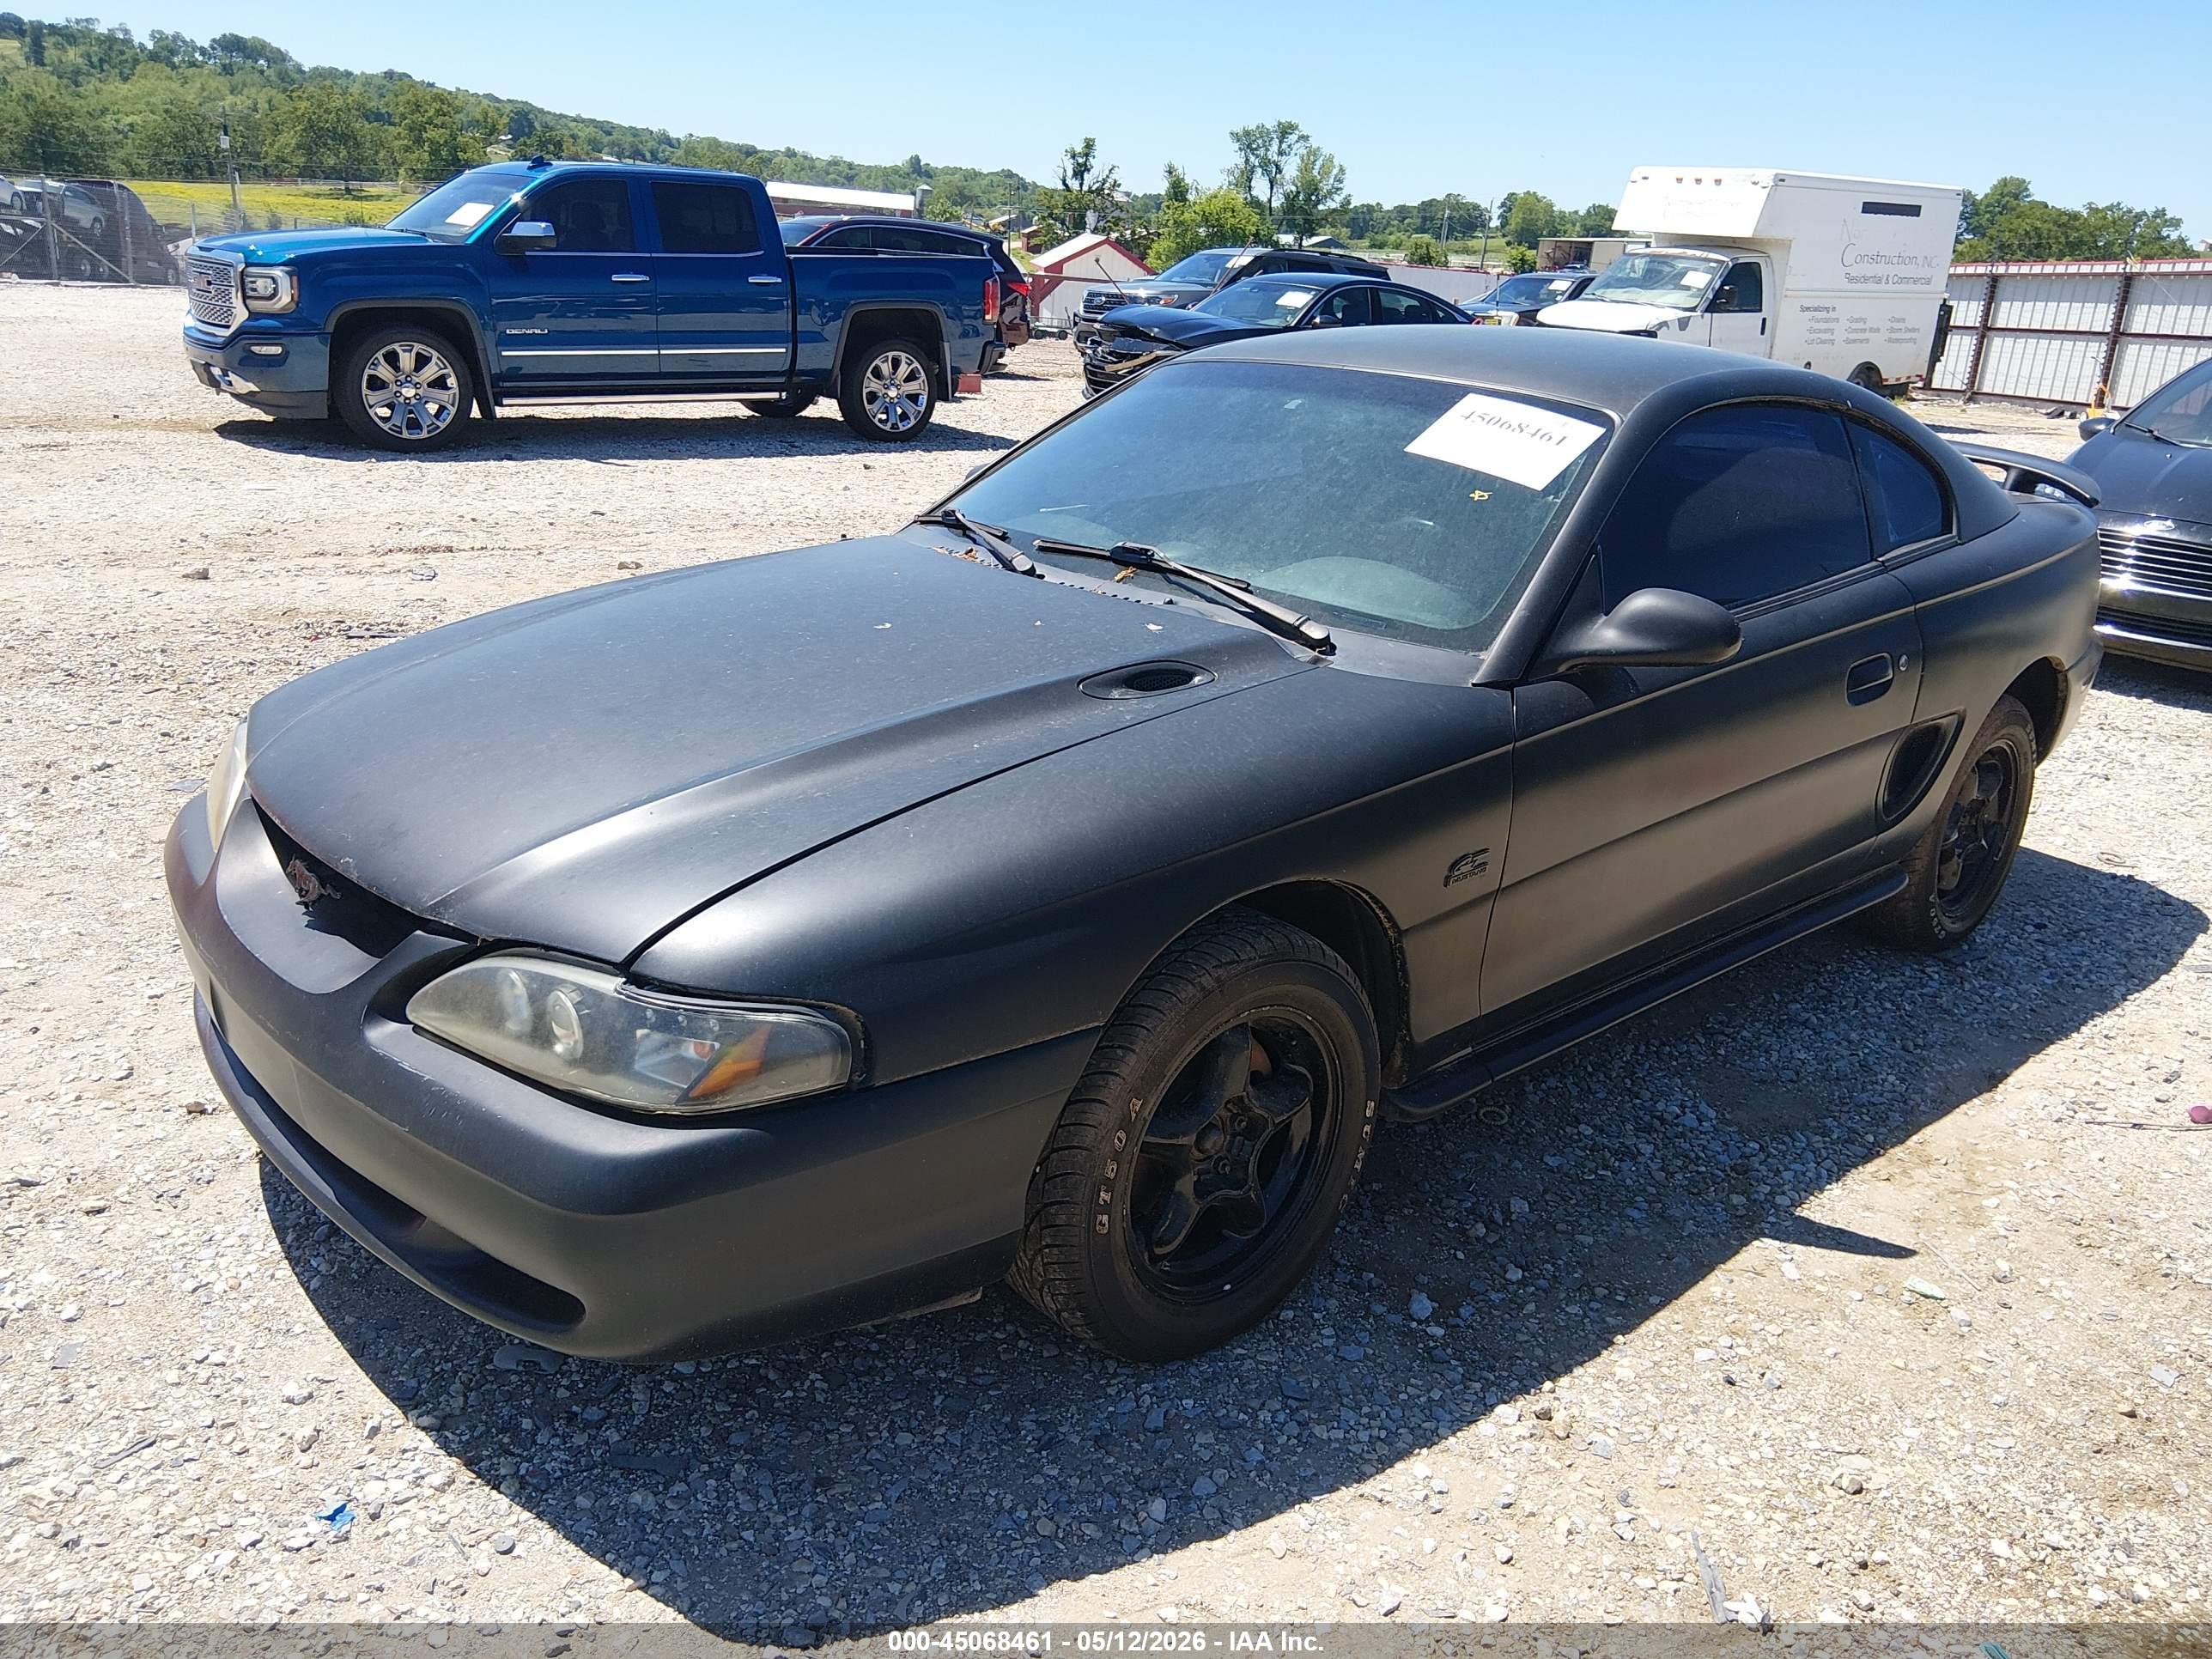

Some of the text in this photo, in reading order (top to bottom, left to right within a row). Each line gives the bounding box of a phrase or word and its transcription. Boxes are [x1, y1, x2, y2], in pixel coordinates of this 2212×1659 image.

[1844, 272, 1933, 285] Residential & Commercial
[1799, 304, 1831, 313] Specializing
[1461, 410, 1568, 447] 45068461
